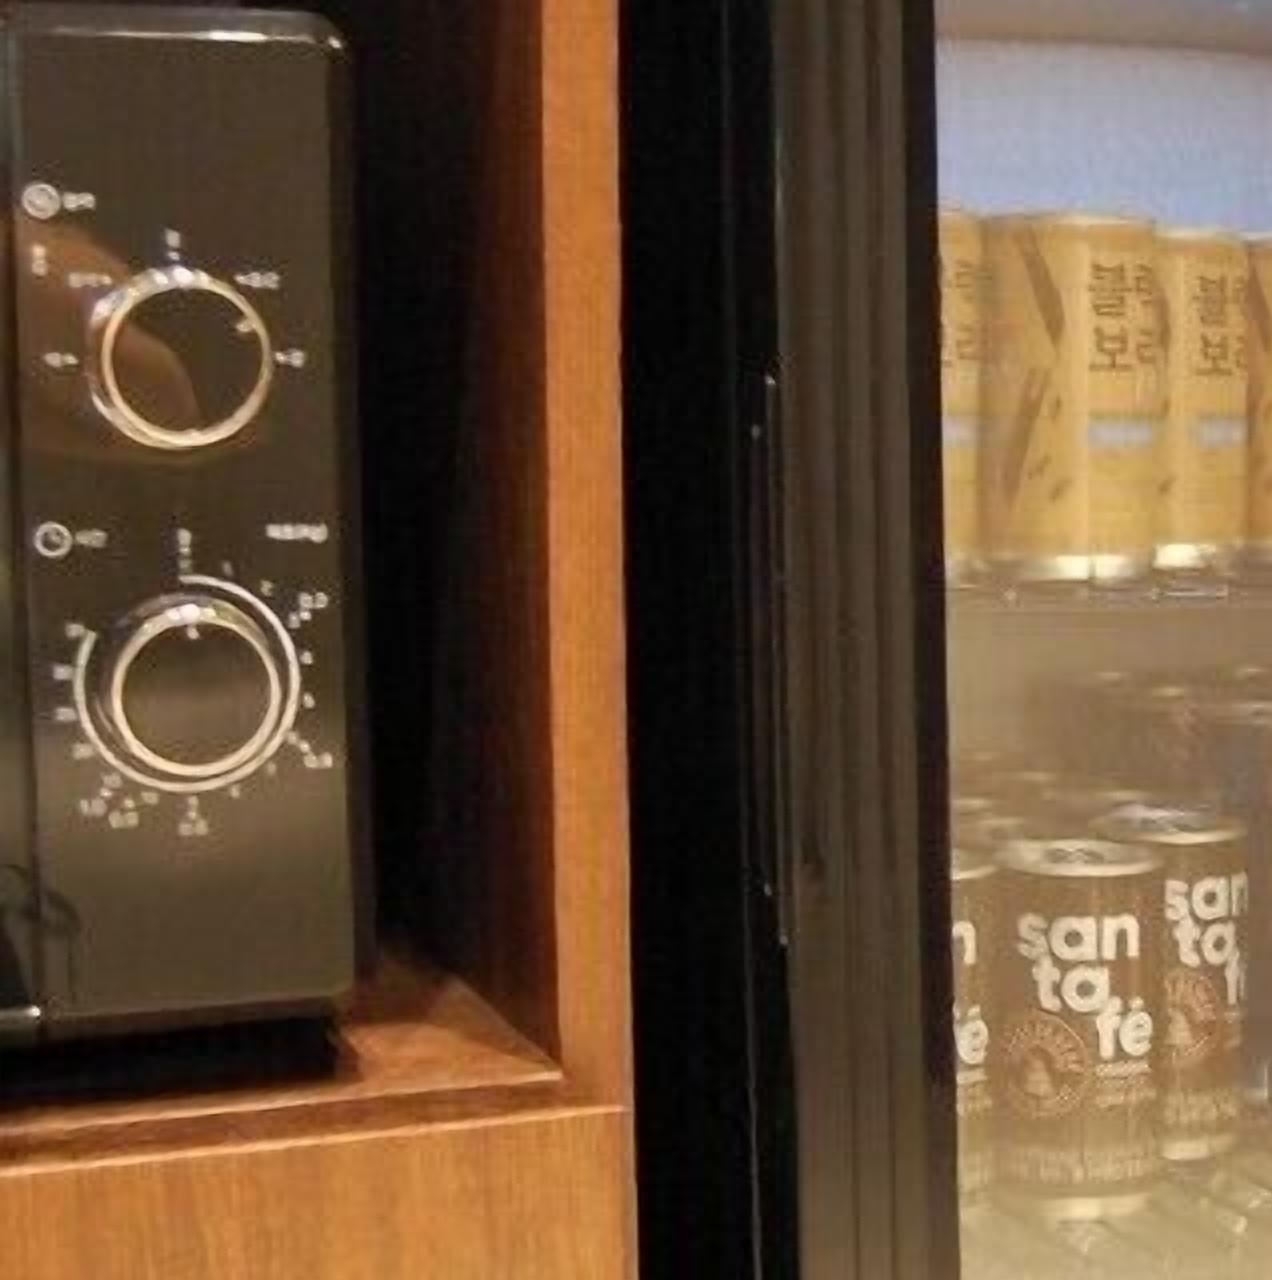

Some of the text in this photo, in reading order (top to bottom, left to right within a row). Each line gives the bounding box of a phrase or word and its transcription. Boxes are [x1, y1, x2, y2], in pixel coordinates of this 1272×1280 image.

[1017, 913, 1140, 962] san
[1172, 916, 1237, 968] ta
[1032, 956, 1112, 1013] ta
[1096, 995, 1153, 1060] fé
